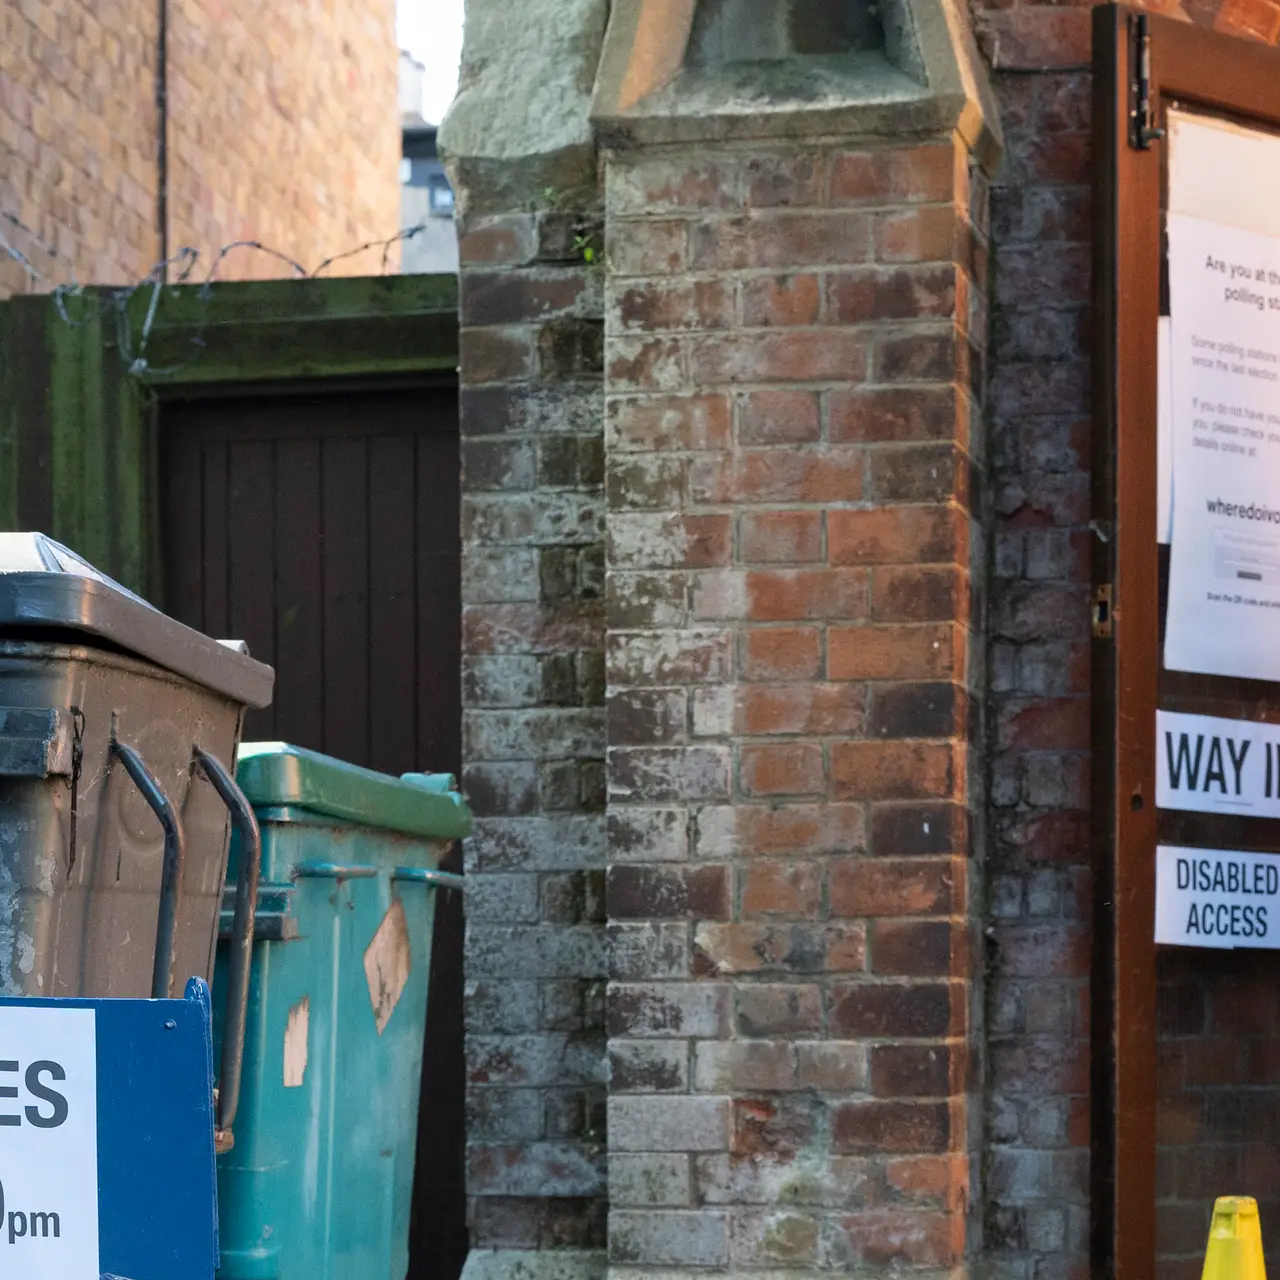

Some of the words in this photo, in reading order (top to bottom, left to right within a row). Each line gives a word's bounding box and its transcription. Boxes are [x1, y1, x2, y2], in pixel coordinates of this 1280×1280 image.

[1205, 256, 1225, 272] Are
[1230, 263, 1250, 281] you
[1254, 269, 1265, 281] at
[1224, 288, 1264, 308] polling
[1165, 731, 1251, 796] WAY
[1176, 857, 1279, 895] DISABLED
[1185, 902, 1269, 938] ACCESS
